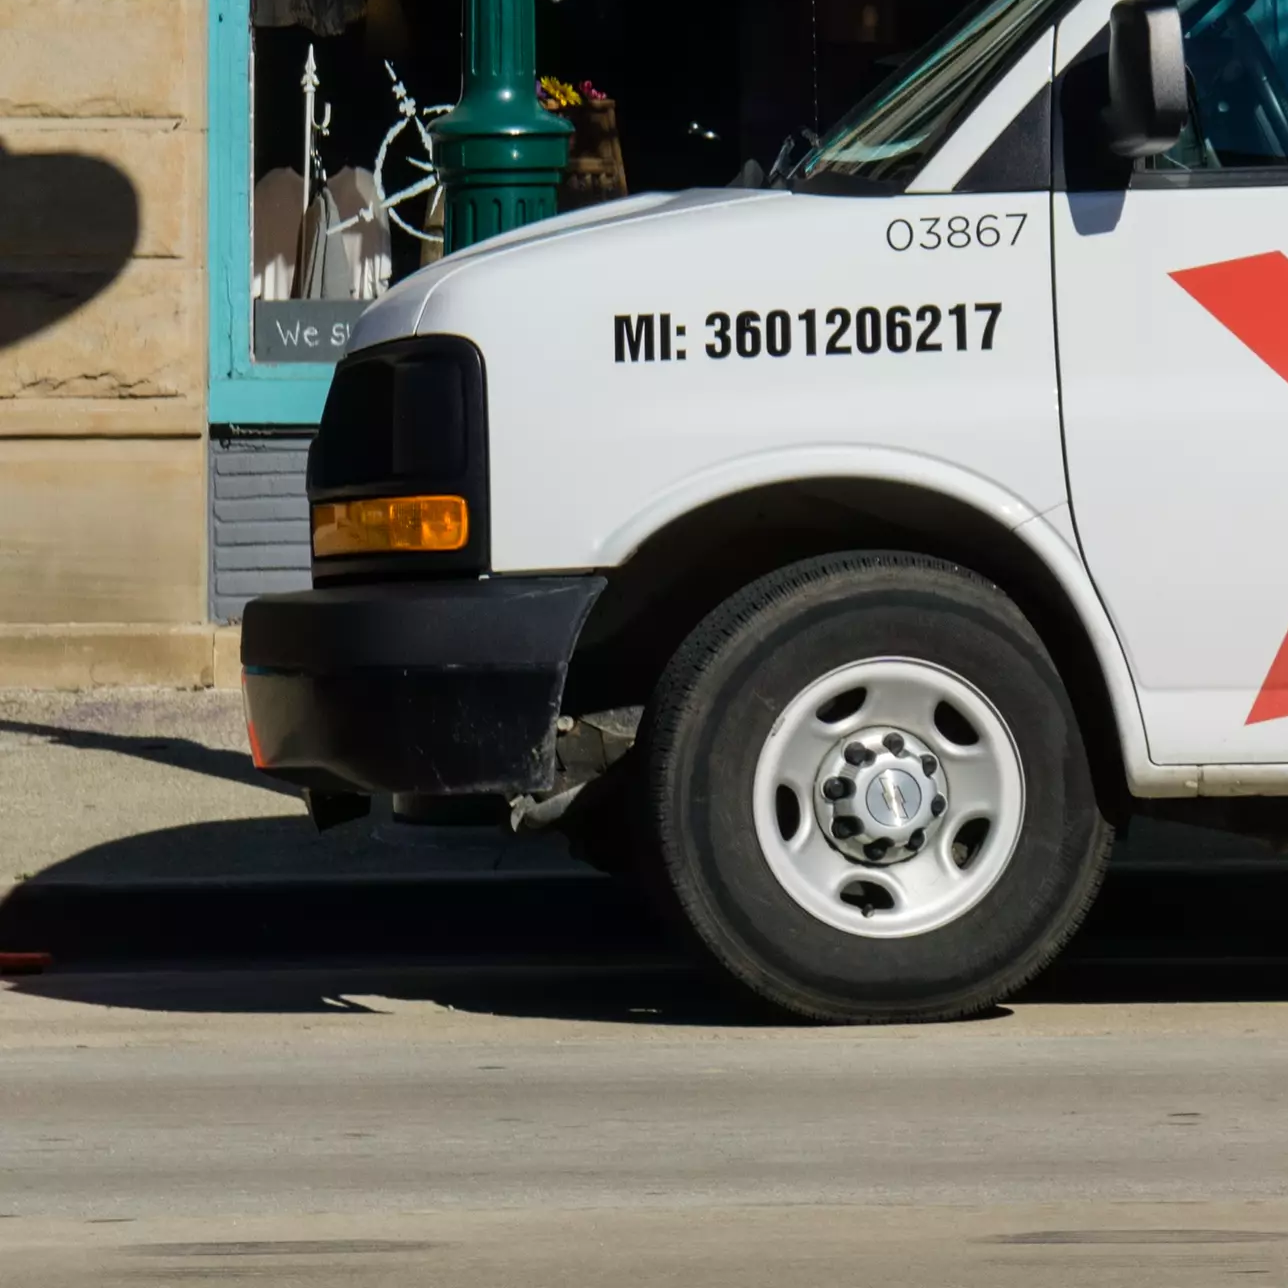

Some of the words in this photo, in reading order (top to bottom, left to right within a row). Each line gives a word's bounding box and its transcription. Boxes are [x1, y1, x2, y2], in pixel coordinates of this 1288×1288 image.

[886, 213, 1028, 251] 03867
[276, 319, 320, 348] We
[614, 313, 687, 362] MI:
[705, 302, 1002, 360] 3601206217
